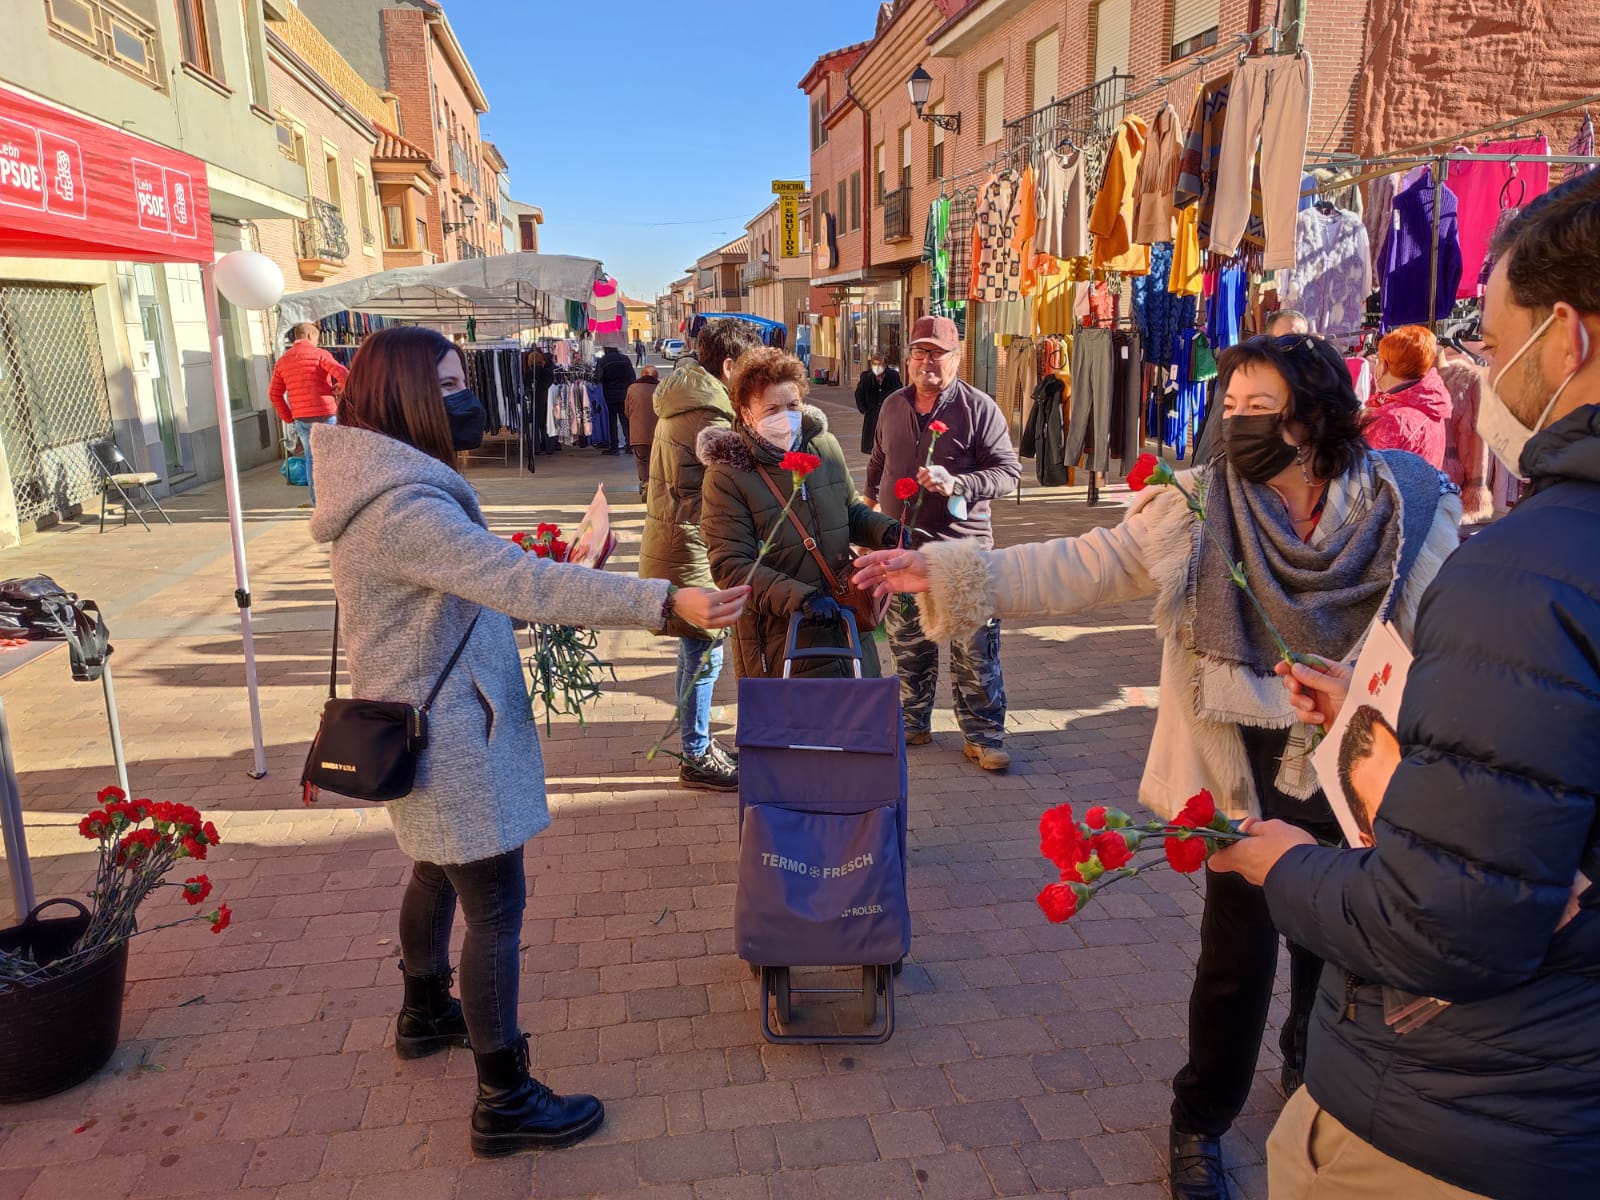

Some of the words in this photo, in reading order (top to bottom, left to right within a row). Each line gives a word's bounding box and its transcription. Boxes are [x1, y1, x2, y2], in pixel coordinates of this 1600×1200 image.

[0, 142, 20, 158] eón
[0, 156, 42, 192] PSOE
[137, 177, 153, 192] León
[138, 191, 167, 218] PSOE
[785, 208, 794, 256] EMBUTIDOS
[761, 853, 807, 875] TERMO
[823, 852, 874, 879] FRESCH
[852, 904, 883, 917] ROLSER
